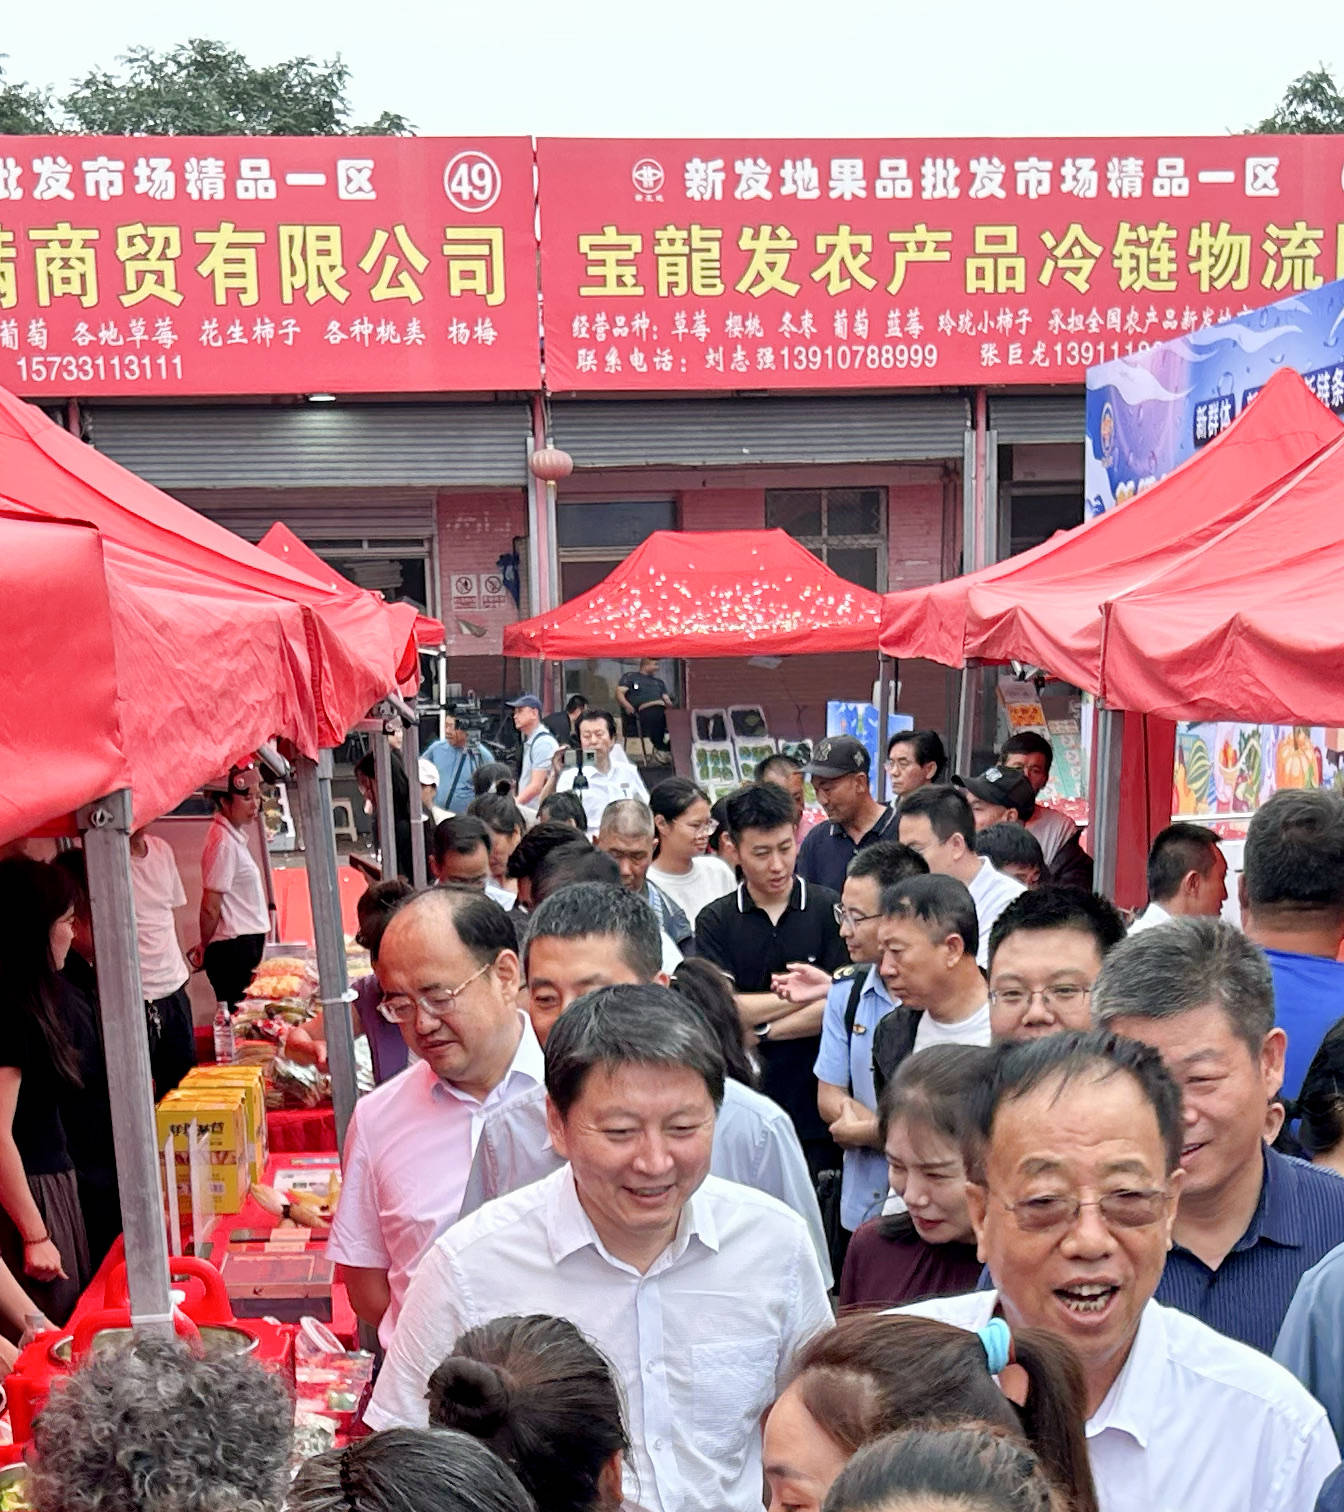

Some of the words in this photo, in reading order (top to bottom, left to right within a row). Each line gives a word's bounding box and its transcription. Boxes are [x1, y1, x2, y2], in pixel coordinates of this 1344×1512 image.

[451, 163, 492, 202] 49
[684, 156, 1280, 201] 新发地果品批发市场精品一区
[0, 318, 47, 350] 葡萄
[71, 316, 178, 349] 各地草莓
[199, 317, 301, 347] 花生柿子
[324, 316, 426, 347] 各种桃类
[447, 318, 498, 346] 杨梅
[572, 311, 658, 342] 经营品种：
[671, 309, 711, 342] 草莓
[725, 312, 764, 338] 樱桃
[833, 308, 869, 340] 葡萄
[885, 307, 924, 339] 蓝莓
[17, 355, 182, 382] 15733113111
